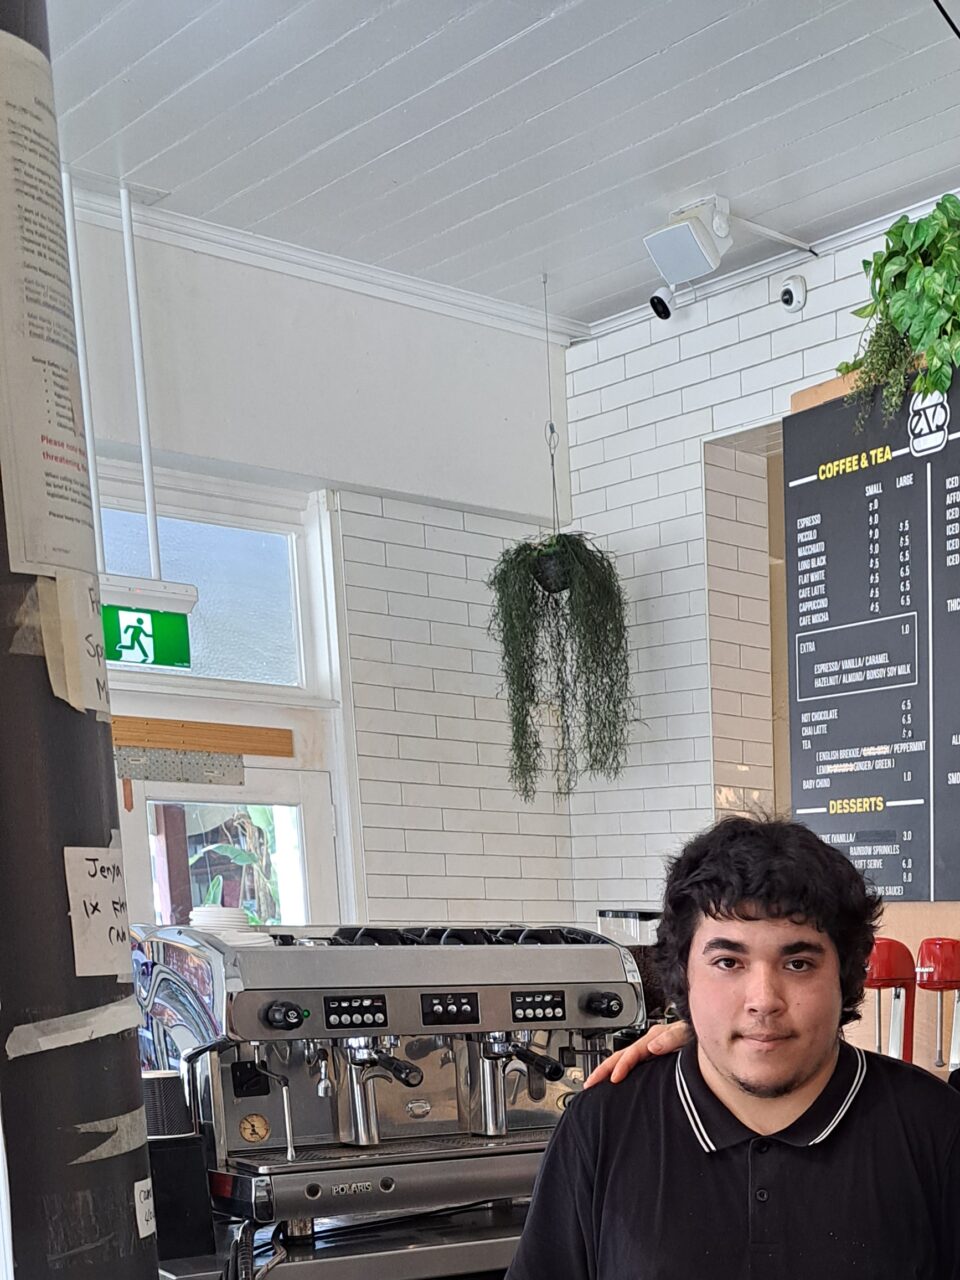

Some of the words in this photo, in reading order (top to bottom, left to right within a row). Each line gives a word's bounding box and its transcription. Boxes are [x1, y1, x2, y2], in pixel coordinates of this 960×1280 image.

[818, 454, 859, 480] COFFEE
[860, 454, 869, 469] &
[870, 445, 892, 465] TEA
[896, 473, 914, 488] LARGE
[945, 476, 959, 490] ICED
[865, 482, 883, 496] SMALL
[946, 507, 959, 521] ICED
[797, 514, 821, 529] ESPRESSO
[797, 529, 817, 543] PICCOLO
[946, 522, 960, 536] ICED
[946, 537, 960, 551] ICED
[798, 559, 810, 571] LONG
[811, 556, 827, 568] BLACK
[946, 553, 960, 567] ICED
[798, 574, 810, 585] FLAT
[810, 570, 825, 582] WHITE
[798, 588, 810, 599] CAFE
[811, 584, 825, 597] LATTE
[799, 598, 828, 613] CAPPUCCINO
[799, 615, 811, 626] CAFE
[812, 612, 829, 625] MOCHA
[901, 624, 910, 635] 1.0
[800, 641, 816, 654] EXTRA
[865, 653, 889, 666] CARAMEL
[887, 666, 898, 677] SOY
[897, 664, 911, 675] MILK
[801, 713, 810, 723] HOT
[811, 709, 838, 722] CHOCOLATE
[802, 725, 813, 737] CHAI
[813, 724, 827, 735] LATTE
[802, 740, 811, 750] TEA
[893, 740, 926, 753] PEPPERMINT
[875, 758, 891, 769] GREEN
[803, 779, 815, 789] BABY
[816, 778, 830, 788] CHINO
[903, 771, 912, 782] 1.0
[829, 796, 884, 814] DESSERTS
[903, 831, 912, 841] 3.0
[850, 846, 872, 856] RAINBOW
[873, 845, 900, 855] SPRINKLES
[867, 859, 883, 868] SERVE
[902, 859, 912, 869] 6.0
[332, 1182, 372, 1196] POLARIS
